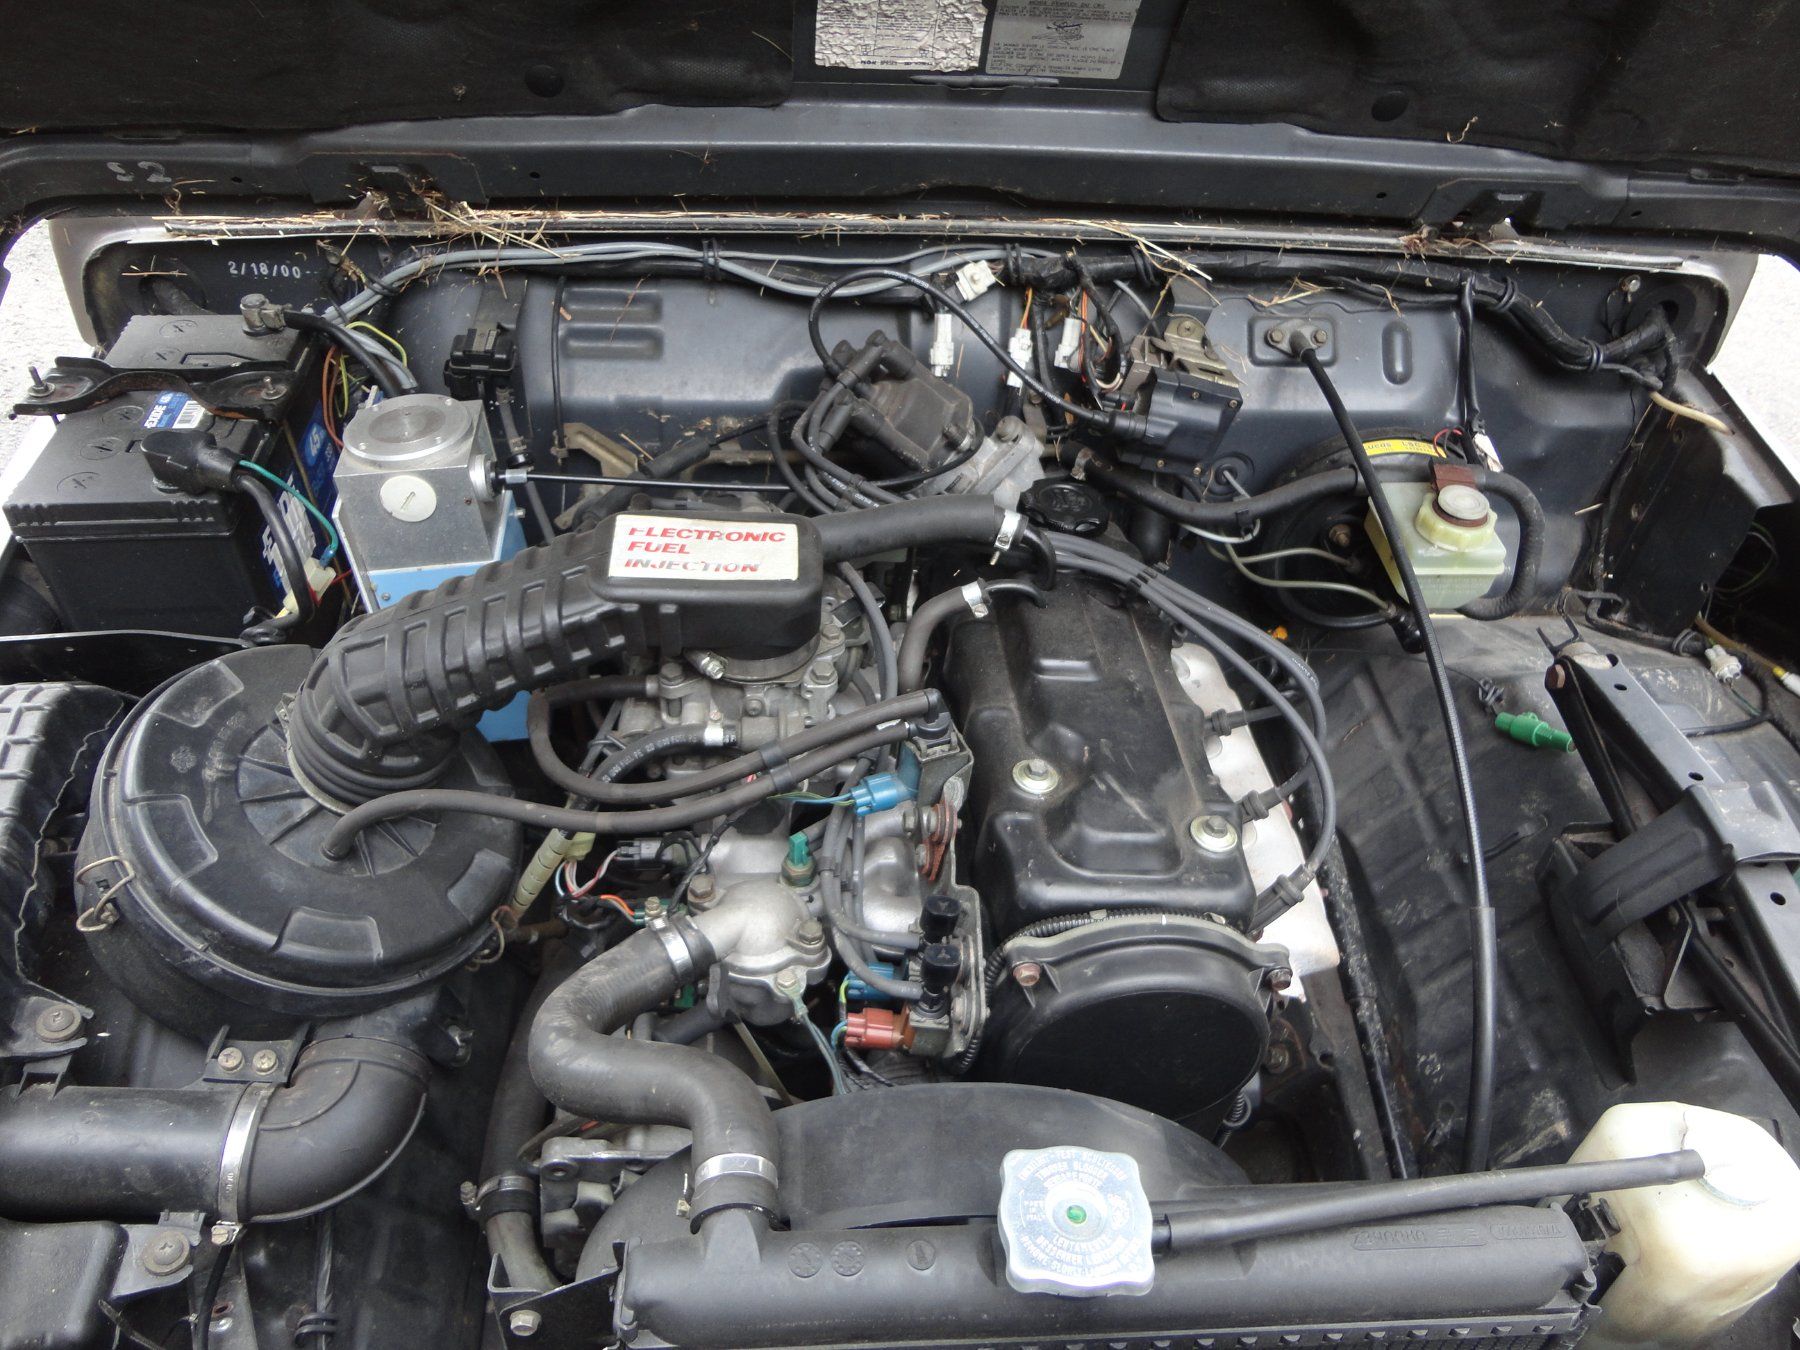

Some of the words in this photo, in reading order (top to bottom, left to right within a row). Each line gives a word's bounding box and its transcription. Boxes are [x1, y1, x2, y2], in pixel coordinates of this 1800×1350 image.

[226, 259, 302, 280] 2/18/00
[628, 526, 787, 543] ELECTRONIC
[627, 541, 691, 555] FUEL
[624, 558, 762, 573] INJECTION
